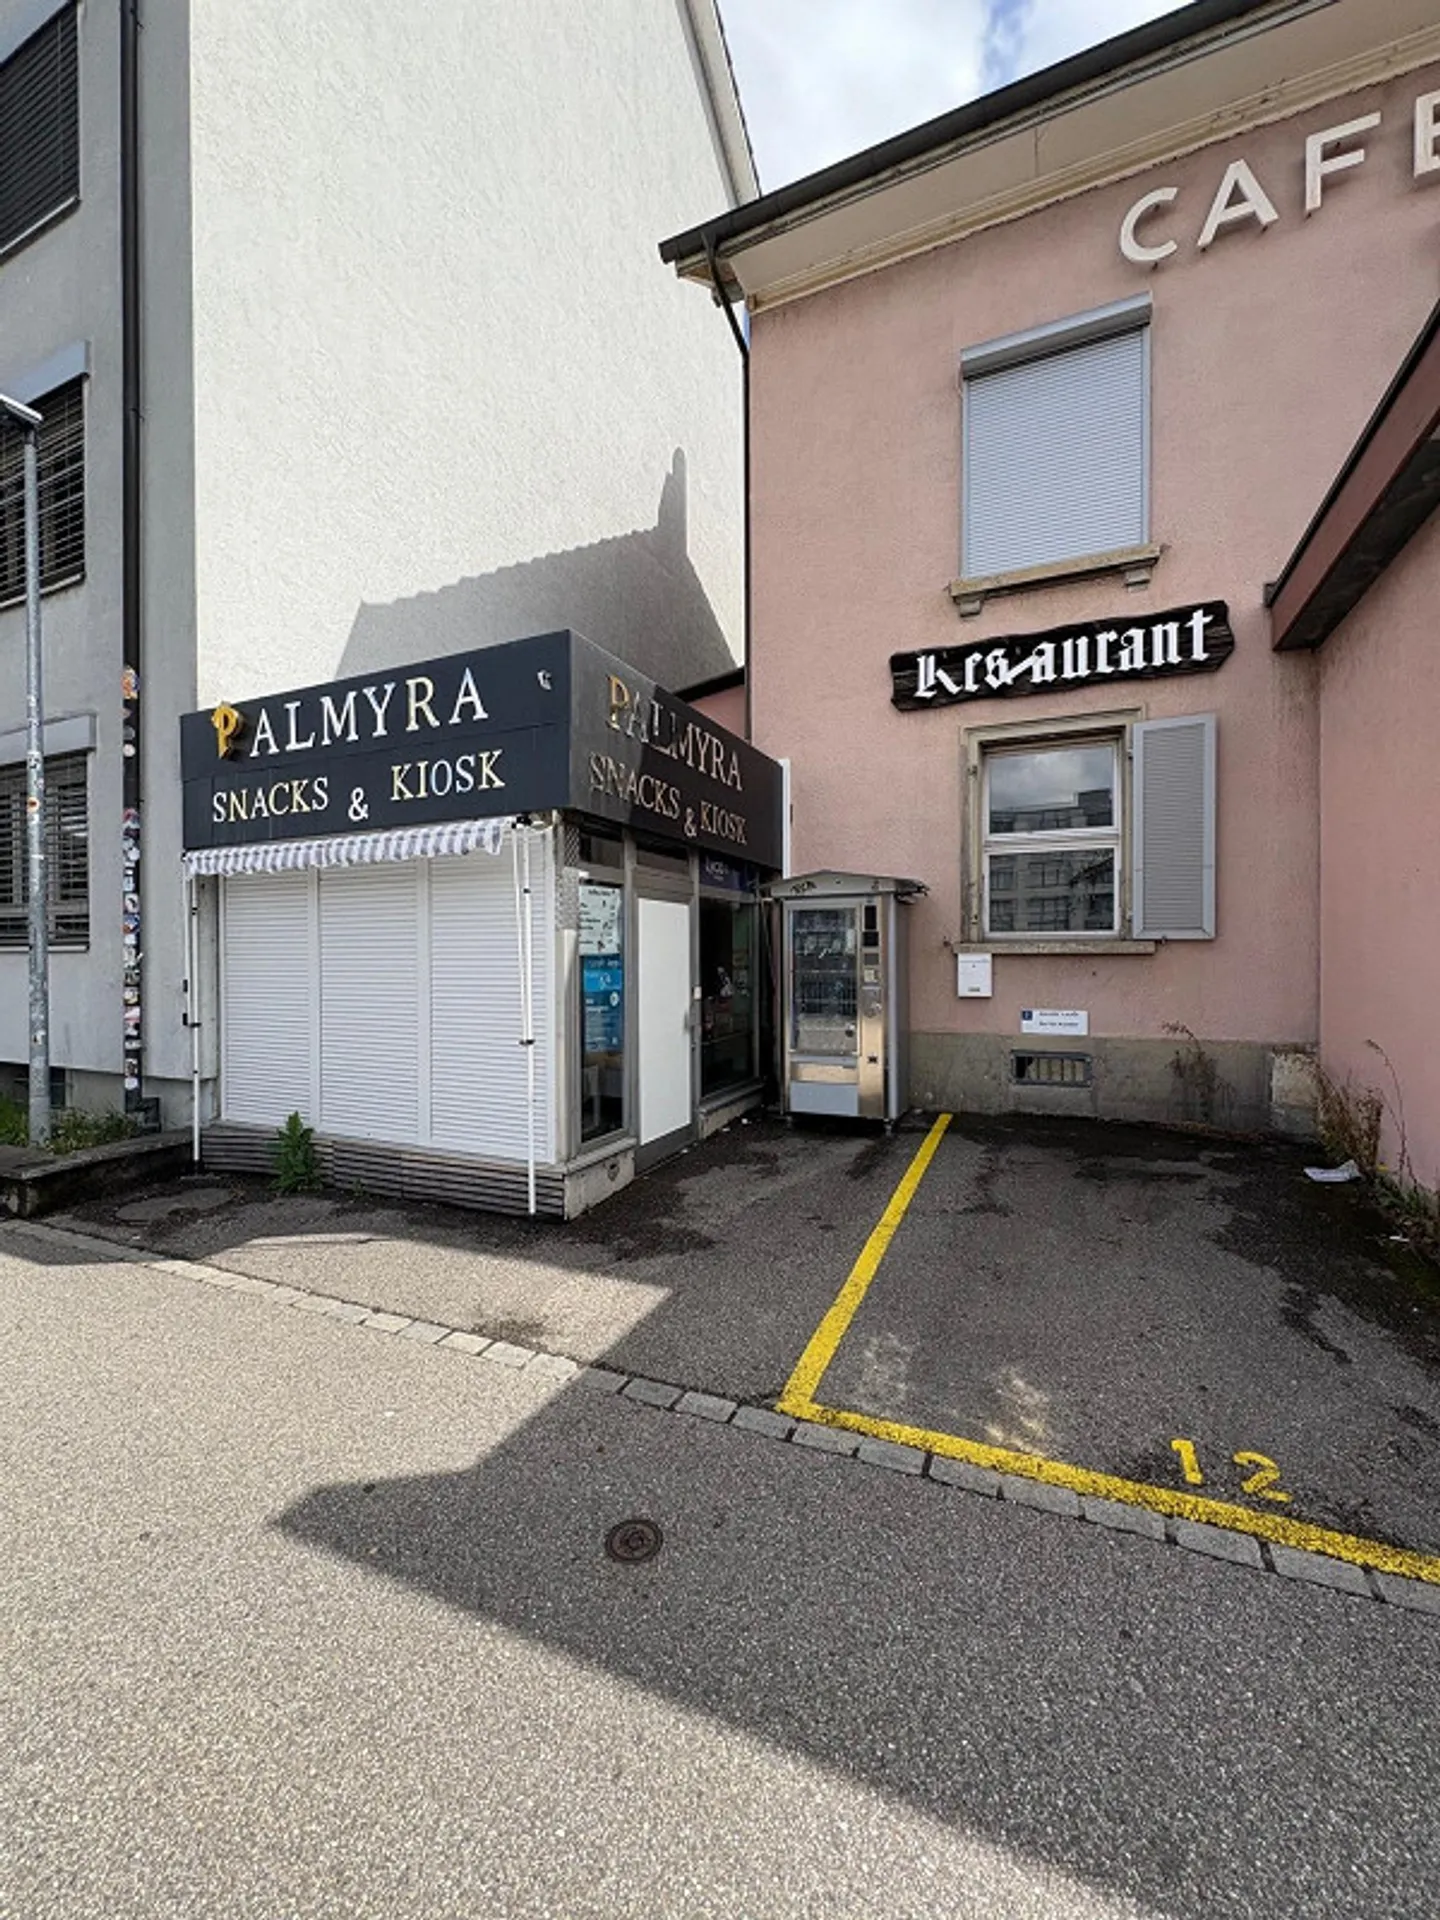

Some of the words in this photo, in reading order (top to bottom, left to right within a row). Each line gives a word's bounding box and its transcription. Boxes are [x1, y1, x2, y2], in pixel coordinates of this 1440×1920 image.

[211, 666, 489, 759] PALMYRA
[605, 674, 742, 791] PALMYRA
[213, 776, 328, 822] SNACKS
[348, 787, 369, 821] &
[390, 749, 505, 801] KIOSK
[589, 752, 680, 820] SNACKS
[684, 806, 697, 837] &
[700, 801, 747, 845] KIOSK
